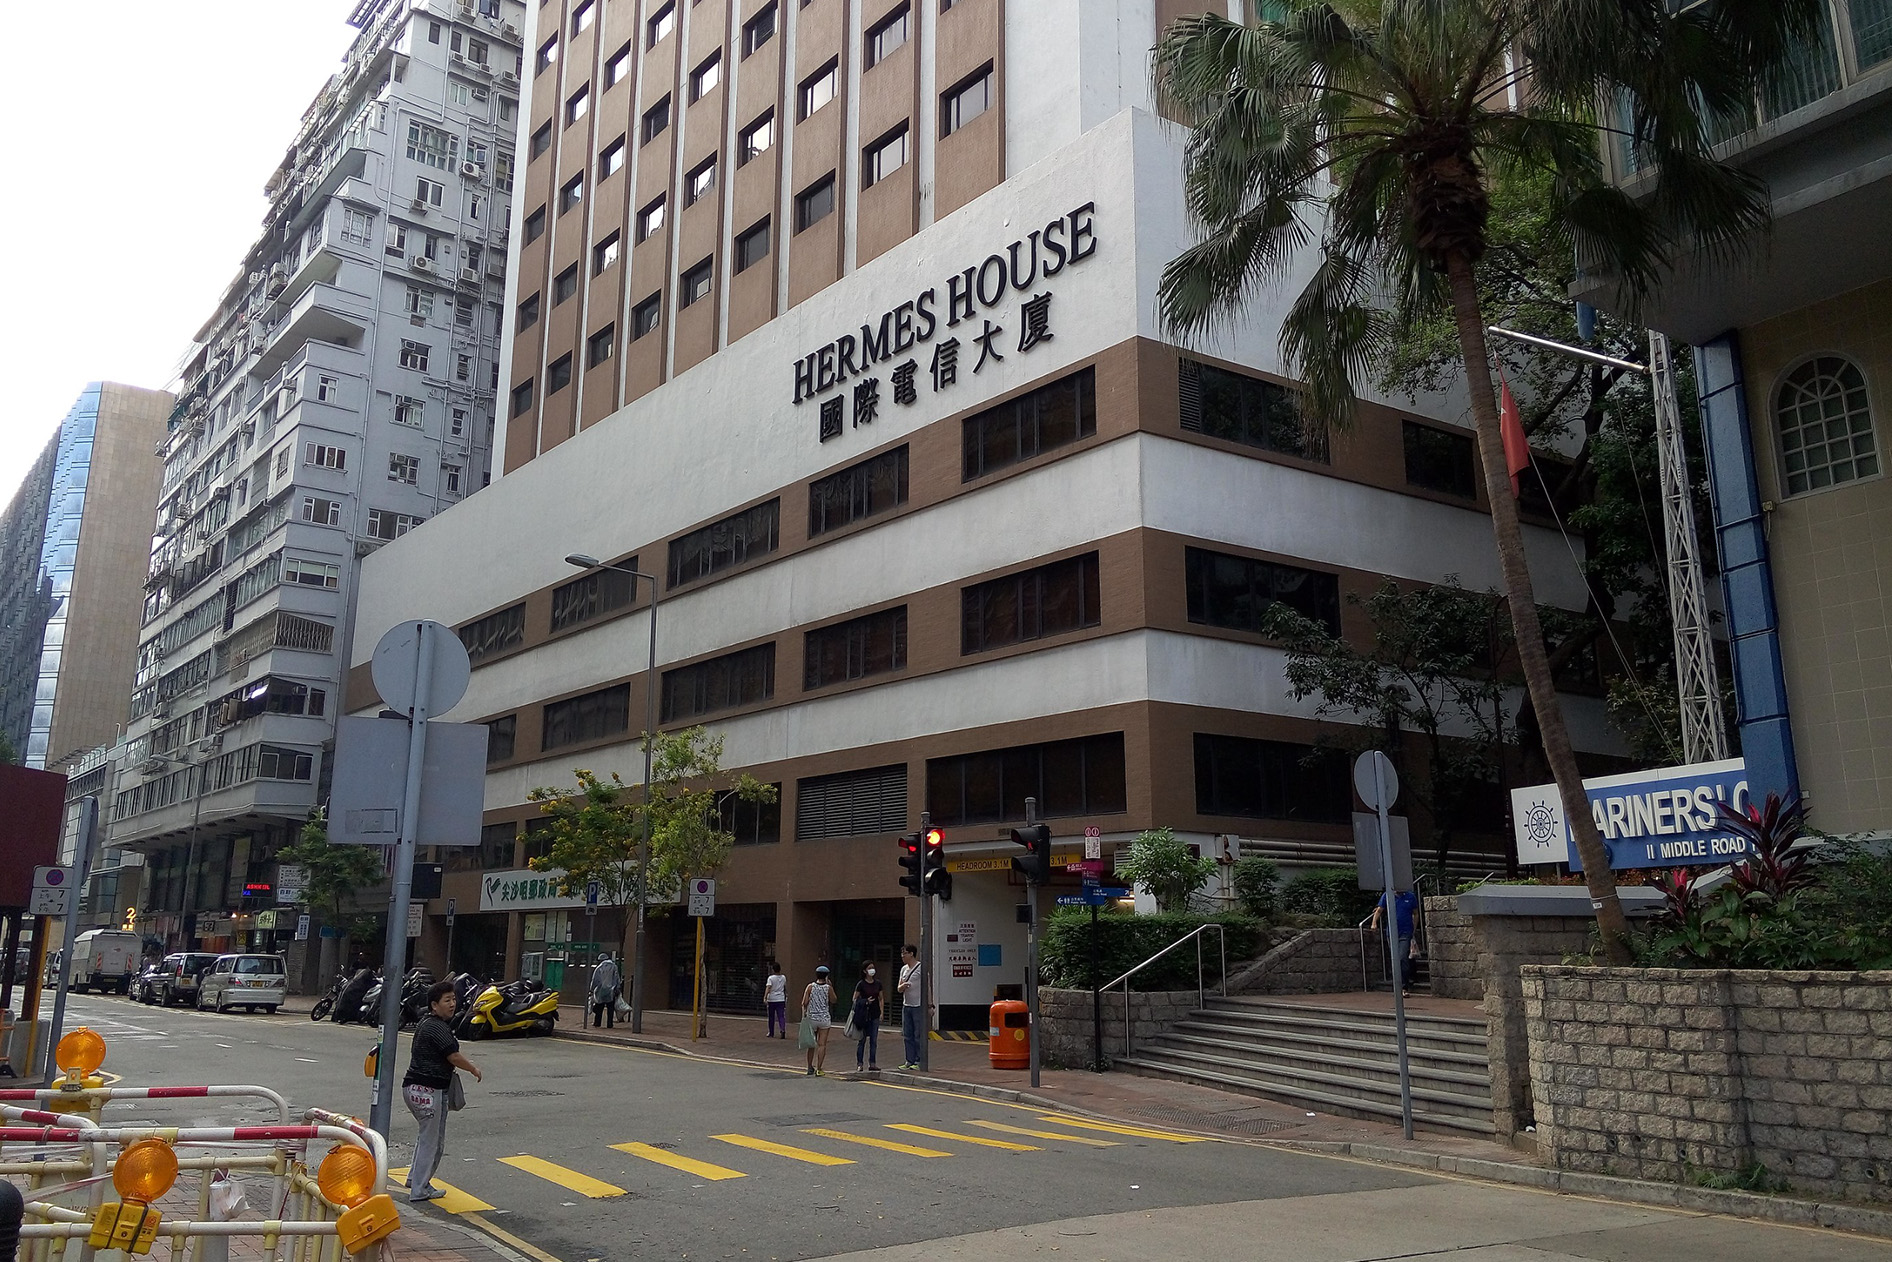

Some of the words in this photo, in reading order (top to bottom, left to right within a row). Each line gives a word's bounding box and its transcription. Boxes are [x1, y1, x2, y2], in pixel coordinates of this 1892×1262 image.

[791, 287, 936, 405] HERMES
[946, 201, 1098, 328] HOUSE
[819, 290, 1055, 443] 國際電信大廈
[1570, 784, 1725, 842] ARINERS'
[1660, 839, 1707, 859] MIDDLE
[1711, 836, 1746, 855] ROAD
[956, 860, 993, 871] HEADROOM
[993, 859, 1009, 869] 3.1M
[1050, 856, 1068, 866] 3.1M
[58, 889, 65, 899] 7
[589, 883, 597, 902] P
[705, 896, 710, 904] 7
[56, 903, 64, 912] 7
[705, 906, 710, 914] 7
